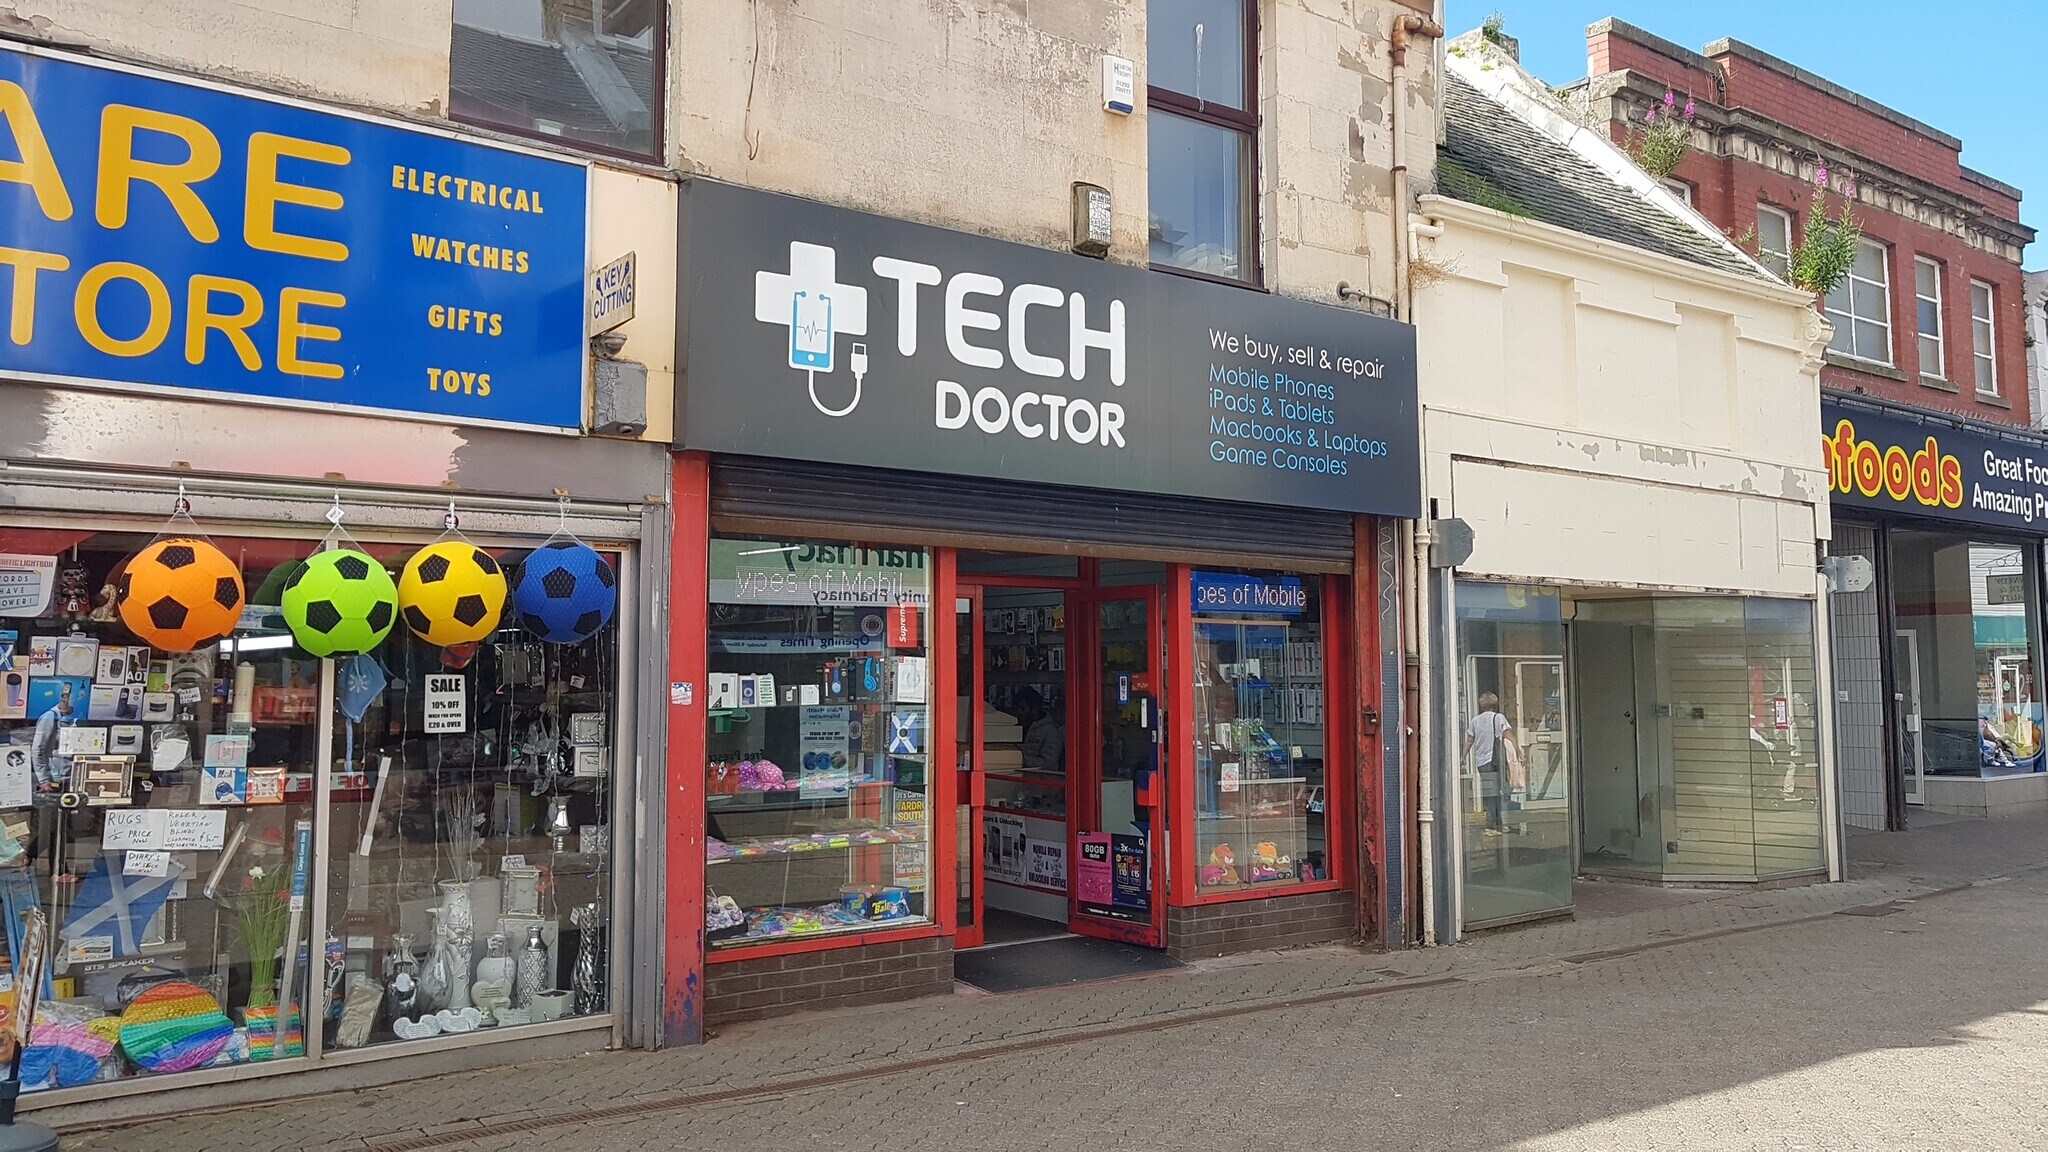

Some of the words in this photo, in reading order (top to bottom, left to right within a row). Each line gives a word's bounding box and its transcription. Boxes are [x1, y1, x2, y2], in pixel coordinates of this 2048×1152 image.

[392, 164, 544, 215] ELECTRICAL
[410, 232, 530, 275] WATCHES
[604, 263, 623, 291] KEY
[593, 283, 632, 319] CUTTING
[428, 304, 503, 337] GIFTS
[872, 256, 1126, 387] TECH
[1209, 328, 1239, 353] We
[1244, 333, 1283, 365] buy,
[1288, 346, 1314, 367] sell
[1319, 349, 1332, 370] &
[1336, 355, 1385, 379] repair
[427, 367, 492, 397] TOYS
[1209, 363, 1270, 391] Mobile
[1275, 372, 1334, 400] Phones
[934, 380, 1126, 448] DOCTOR
[1209, 387, 1256, 414] iPads
[1261, 396, 1274, 416] &
[1278, 398, 1335, 425] Tablets
[1209, 414, 1302, 446] Macbooks
[1307, 427, 1320, 448] &
[1324, 429, 1387, 459] Laptops
[1210, 440, 1267, 467] Game
[1272, 448, 1347, 476] Consoles
[1983, 449, 2023, 482] Great
[1972, 482, 2033, 523] Amazing
[808, 569, 833, 594] of
[1232, 583, 1250, 605] of
[1254, 583, 1306, 607] Mobile
[898, 603, 907, 643] Supreme
[430, 679, 461, 693] SALE
[432, 701, 446, 709] 10%
[447, 700, 460, 709] OFF
[107, 811, 143, 826] RUGS
[128, 829, 152, 838] PRICE
[1000, 818, 1023, 828] Unlocking
[1084, 844, 1105, 854] 80GB
[107, 957, 155, 969] SPEAKER
